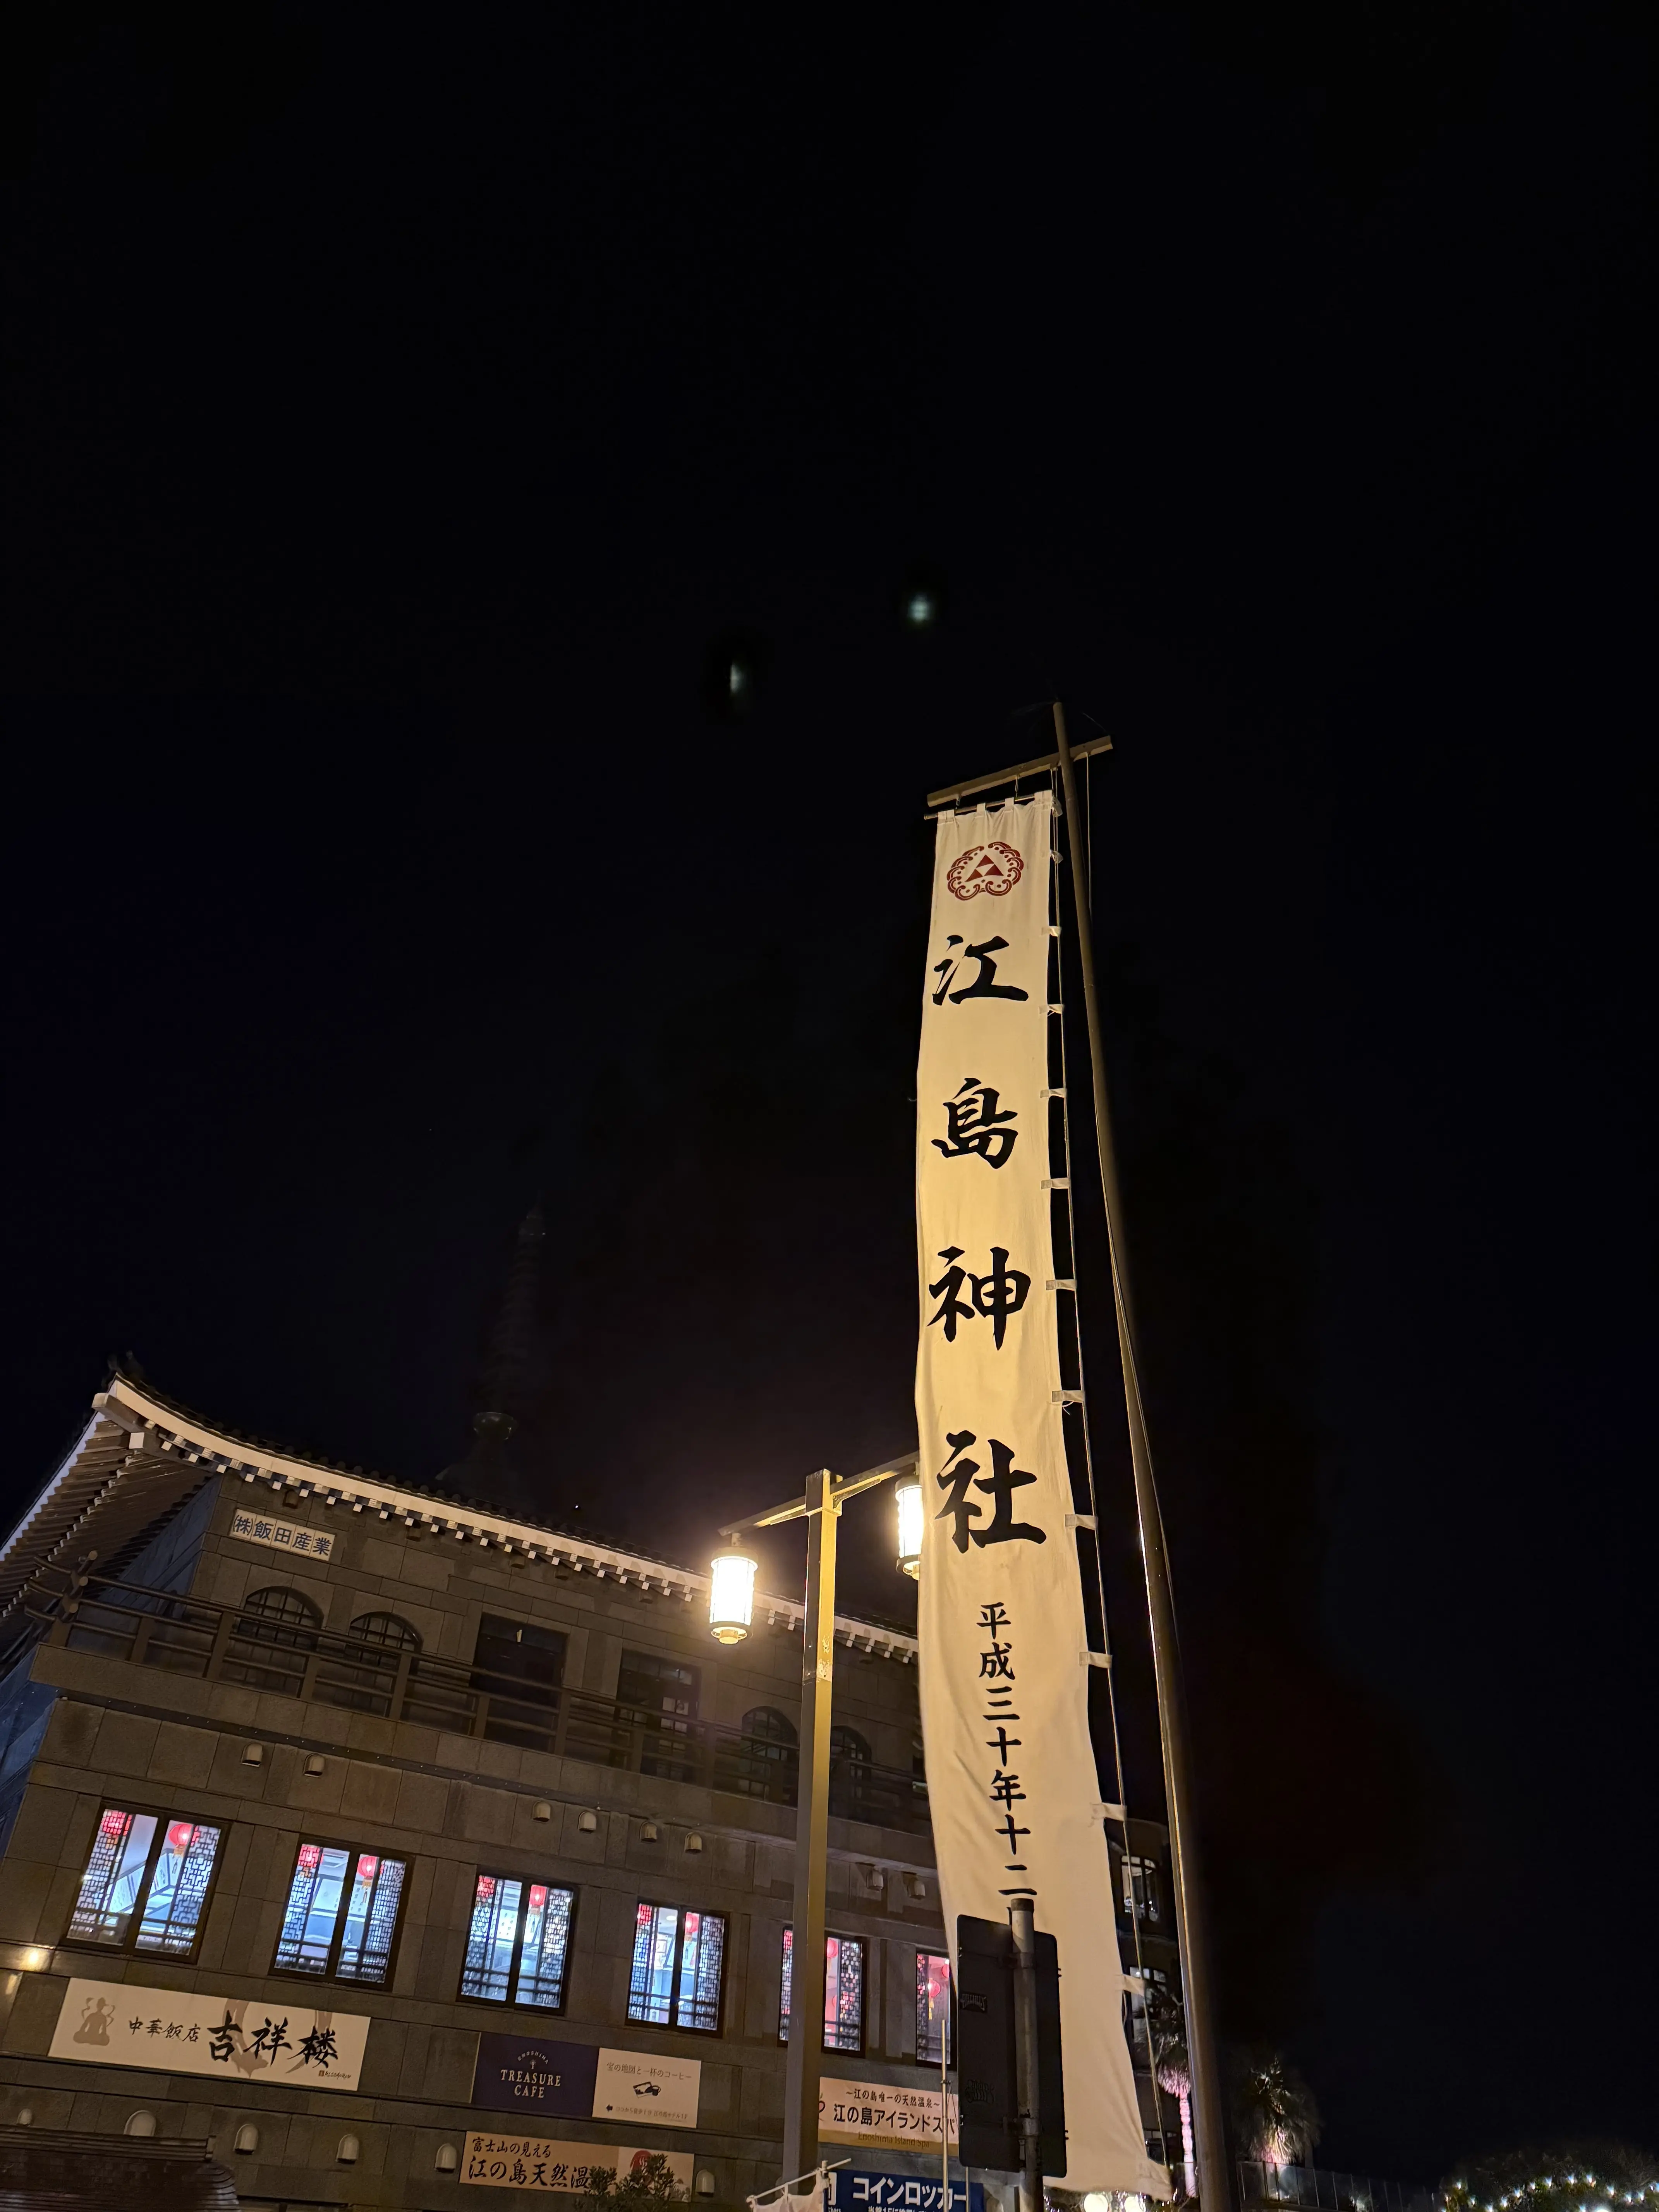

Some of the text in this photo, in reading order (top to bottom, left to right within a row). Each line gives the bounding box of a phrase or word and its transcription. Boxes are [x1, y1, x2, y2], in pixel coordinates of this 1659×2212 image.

[927, 934, 1047, 1554] 江島神社
[976, 1602, 1037, 1925] 平成三十年十二
[129, 2010, 338, 2068] 中華飯店 吉祥楼
[500, 2069, 561, 2087] TREASURE
[606, 2062, 692, 2080] 宝の地図と一杯のコーヒー
[514, 2085, 544, 2098] CAFE
[833, 2104, 955, 2134] 江の島アイランドスパ
[472, 2136, 551, 2158] 富士山の見える
[858, 2131, 929, 2149] Enoshima Island Spa
[469, 2155, 592, 2189] 江の島天然温
[853, 2176, 967, 2210] コインロッカー
